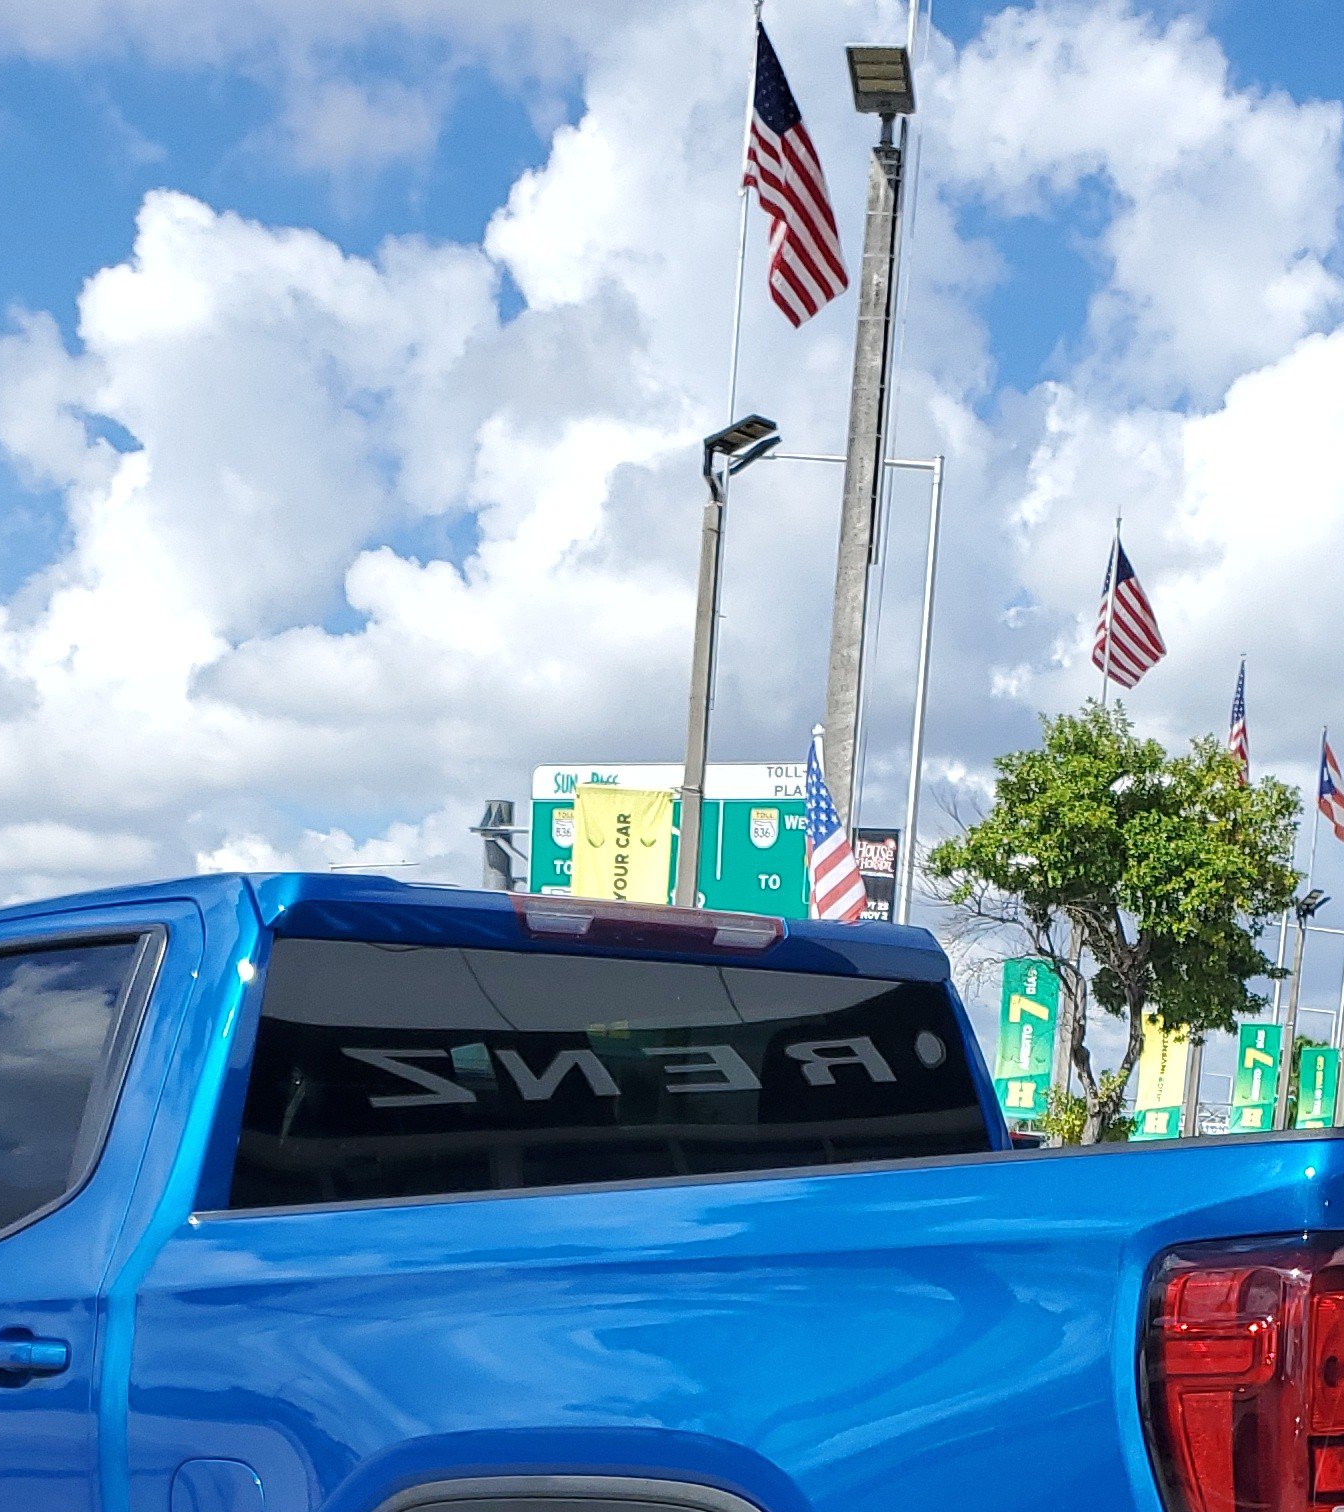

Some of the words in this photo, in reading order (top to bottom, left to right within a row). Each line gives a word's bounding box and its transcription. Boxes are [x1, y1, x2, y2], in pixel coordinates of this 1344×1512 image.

[554, 772, 578, 793] SUN
[775, 785, 806, 797] PLA
[616, 813, 632, 848] CAR
[784, 815, 807, 830] WE
[613, 854, 630, 901] YOUR
[758, 874, 781, 890] TO
[1009, 994, 1049, 1023] 7
[1160, 1033, 1169, 1074] INVENTO
[1244, 1048, 1274, 1069] 7
[1006, 1081, 1037, 1108] H
